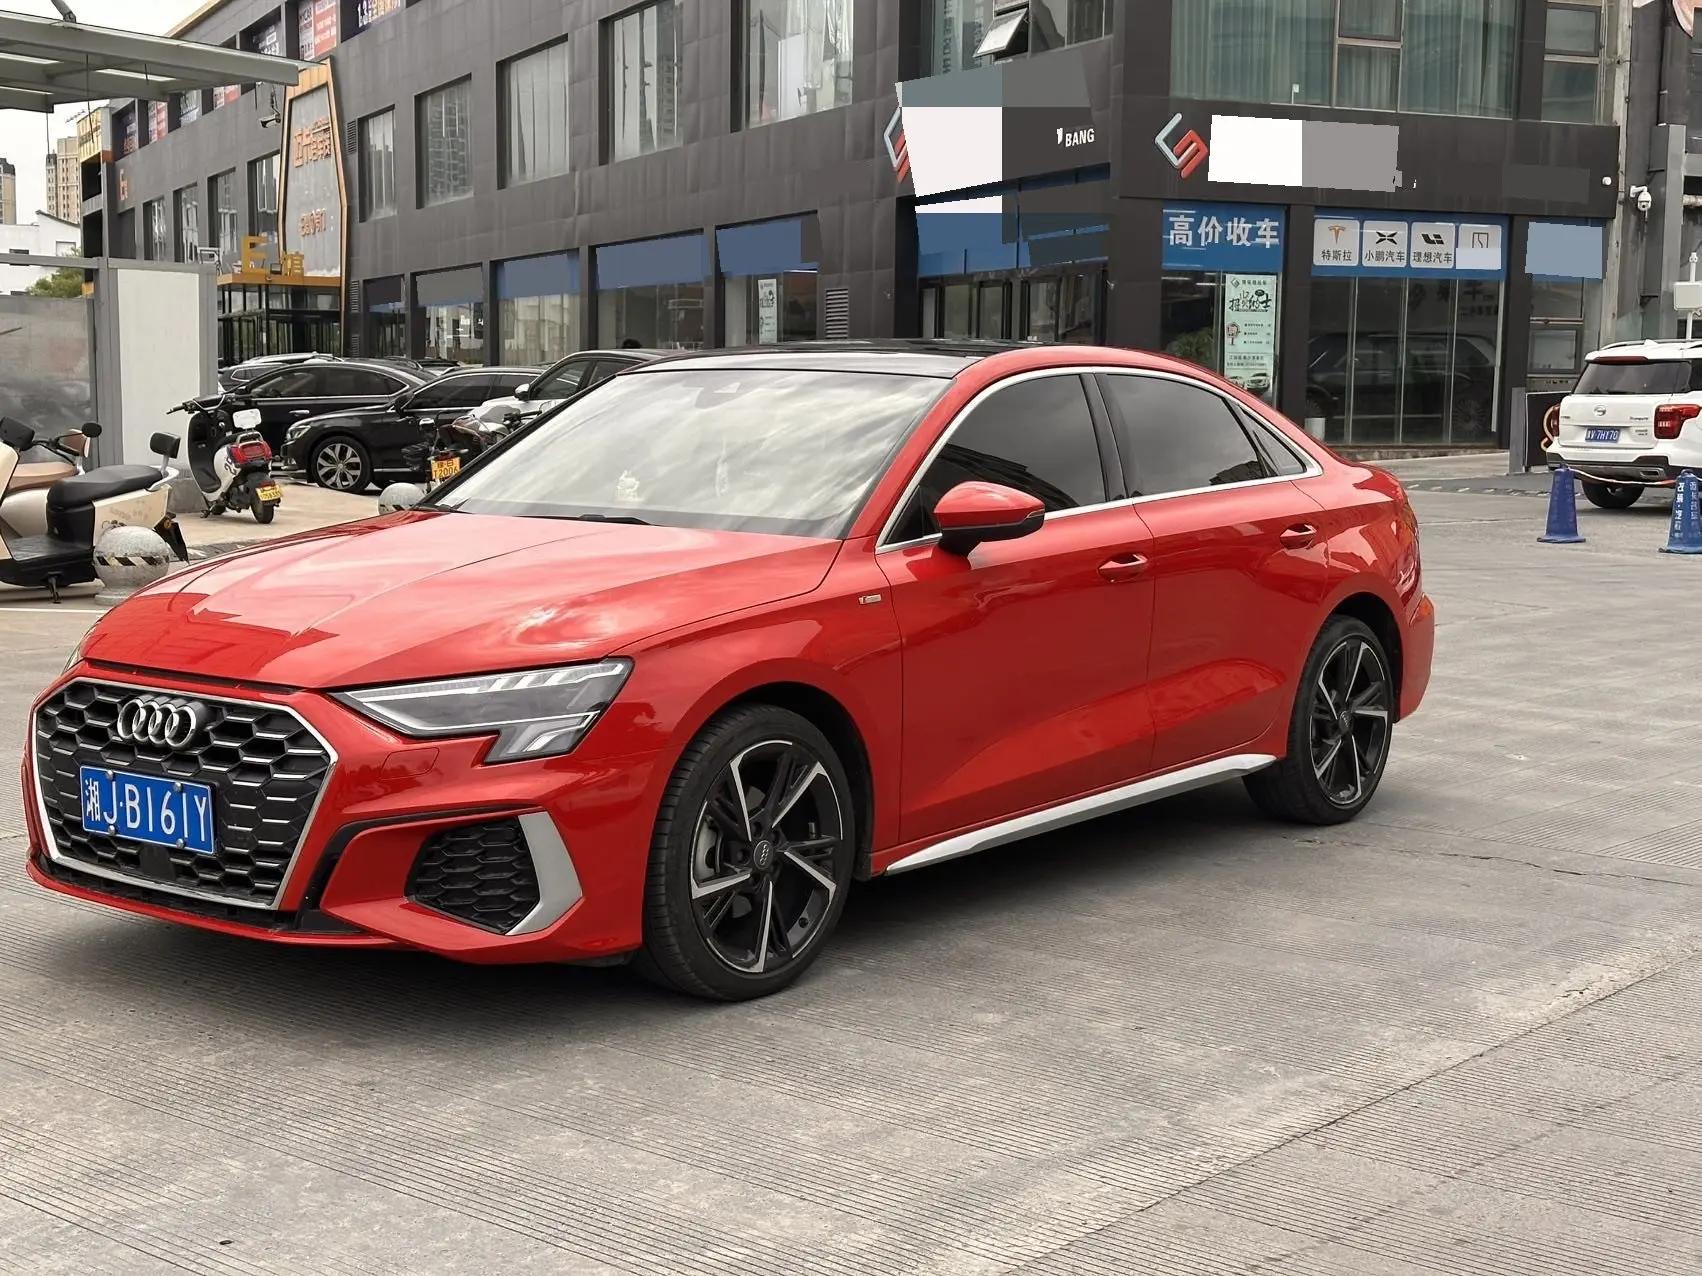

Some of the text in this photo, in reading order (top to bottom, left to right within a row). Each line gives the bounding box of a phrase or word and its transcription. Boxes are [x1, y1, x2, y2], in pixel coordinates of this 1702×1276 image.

[1065, 128, 1095, 148] BANG
[1168, 214, 1280, 249] 高价收车
[1321, 249, 1352, 262] 特斯拉
[1364, 250, 1406, 263] 小鹏汽车
[1412, 251, 1453, 264] 理想汽车
